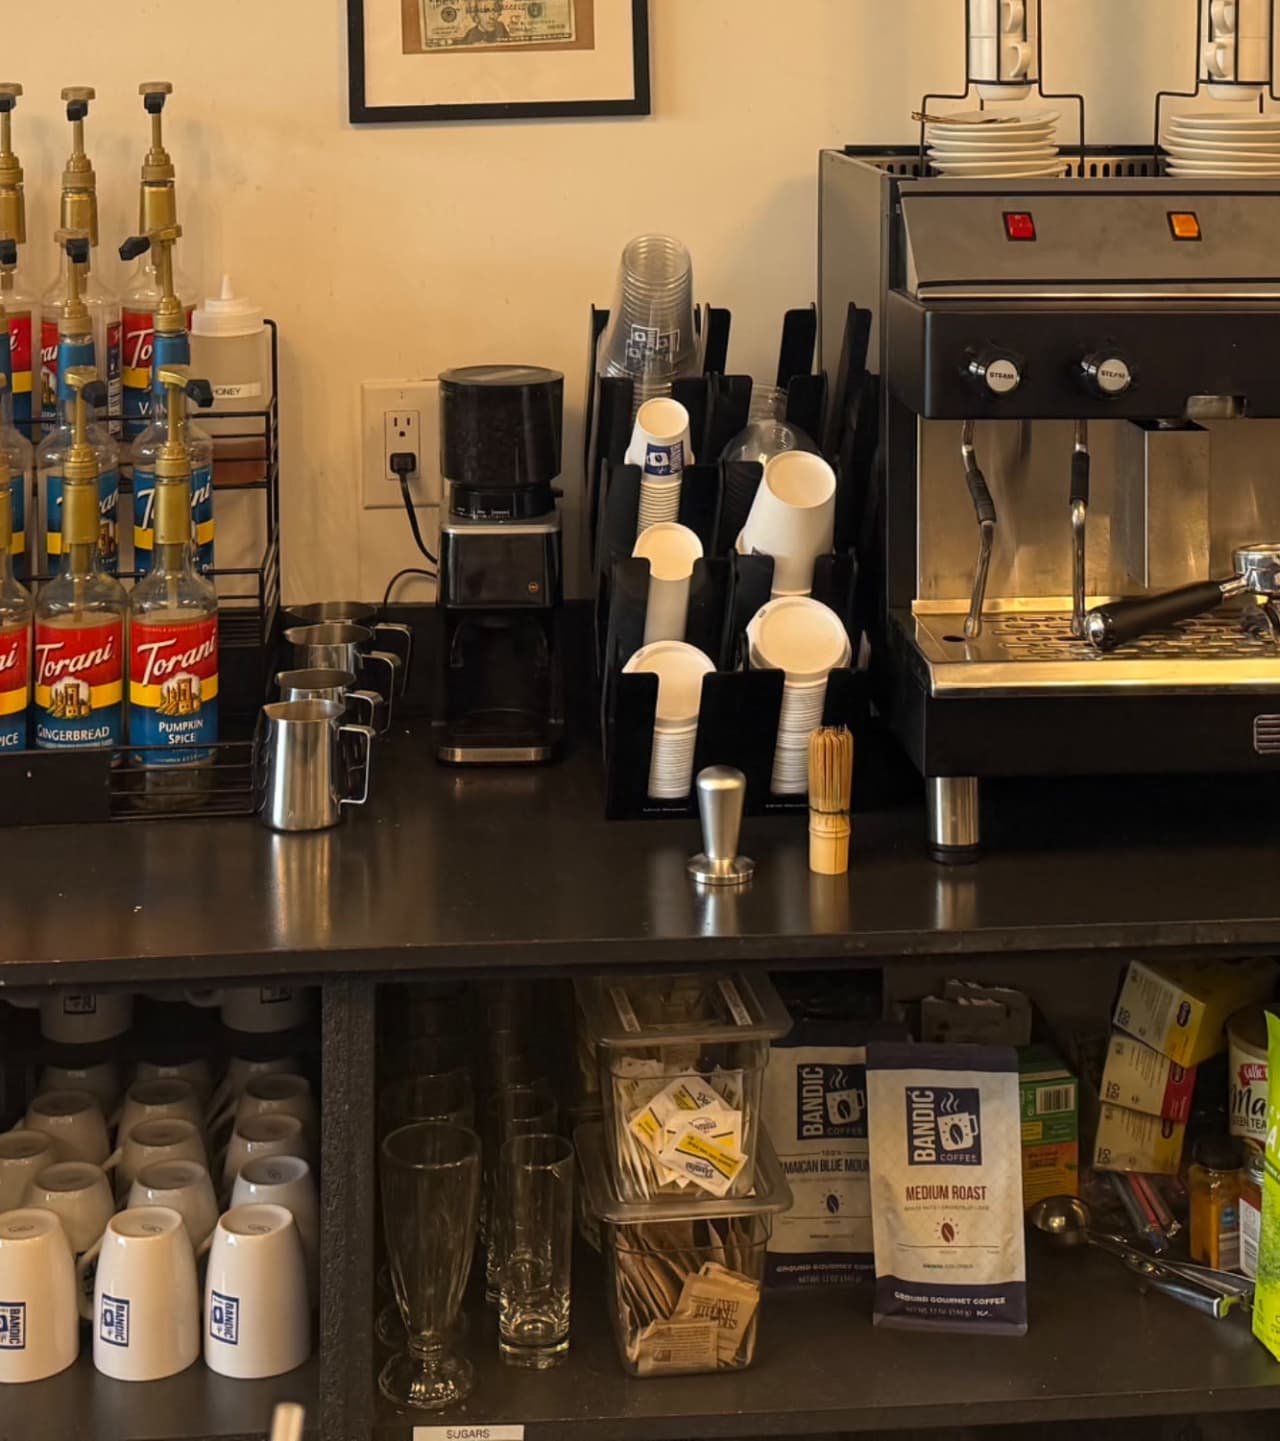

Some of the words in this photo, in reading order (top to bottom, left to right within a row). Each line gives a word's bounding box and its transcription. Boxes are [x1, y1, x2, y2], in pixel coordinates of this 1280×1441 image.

[989, 372, 1015, 380] STEAM
[137, 636, 217, 688] Torani
[37, 725, 110, 742] GINGERBREAD
[158, 718, 204, 734] PUMPKIN
[168, 731, 197, 745] SPICE
[907, 1089, 937, 1162] BANDIĆ
[939, 1153, 978, 1163] COFFEE
[905, 1185, 949, 1202] MEDIUM
[951, 1184, 987, 1201] ROAST
[973, 1295, 1008, 1306] COFFEE
[446, 1428, 491, 1440] SUGARS
